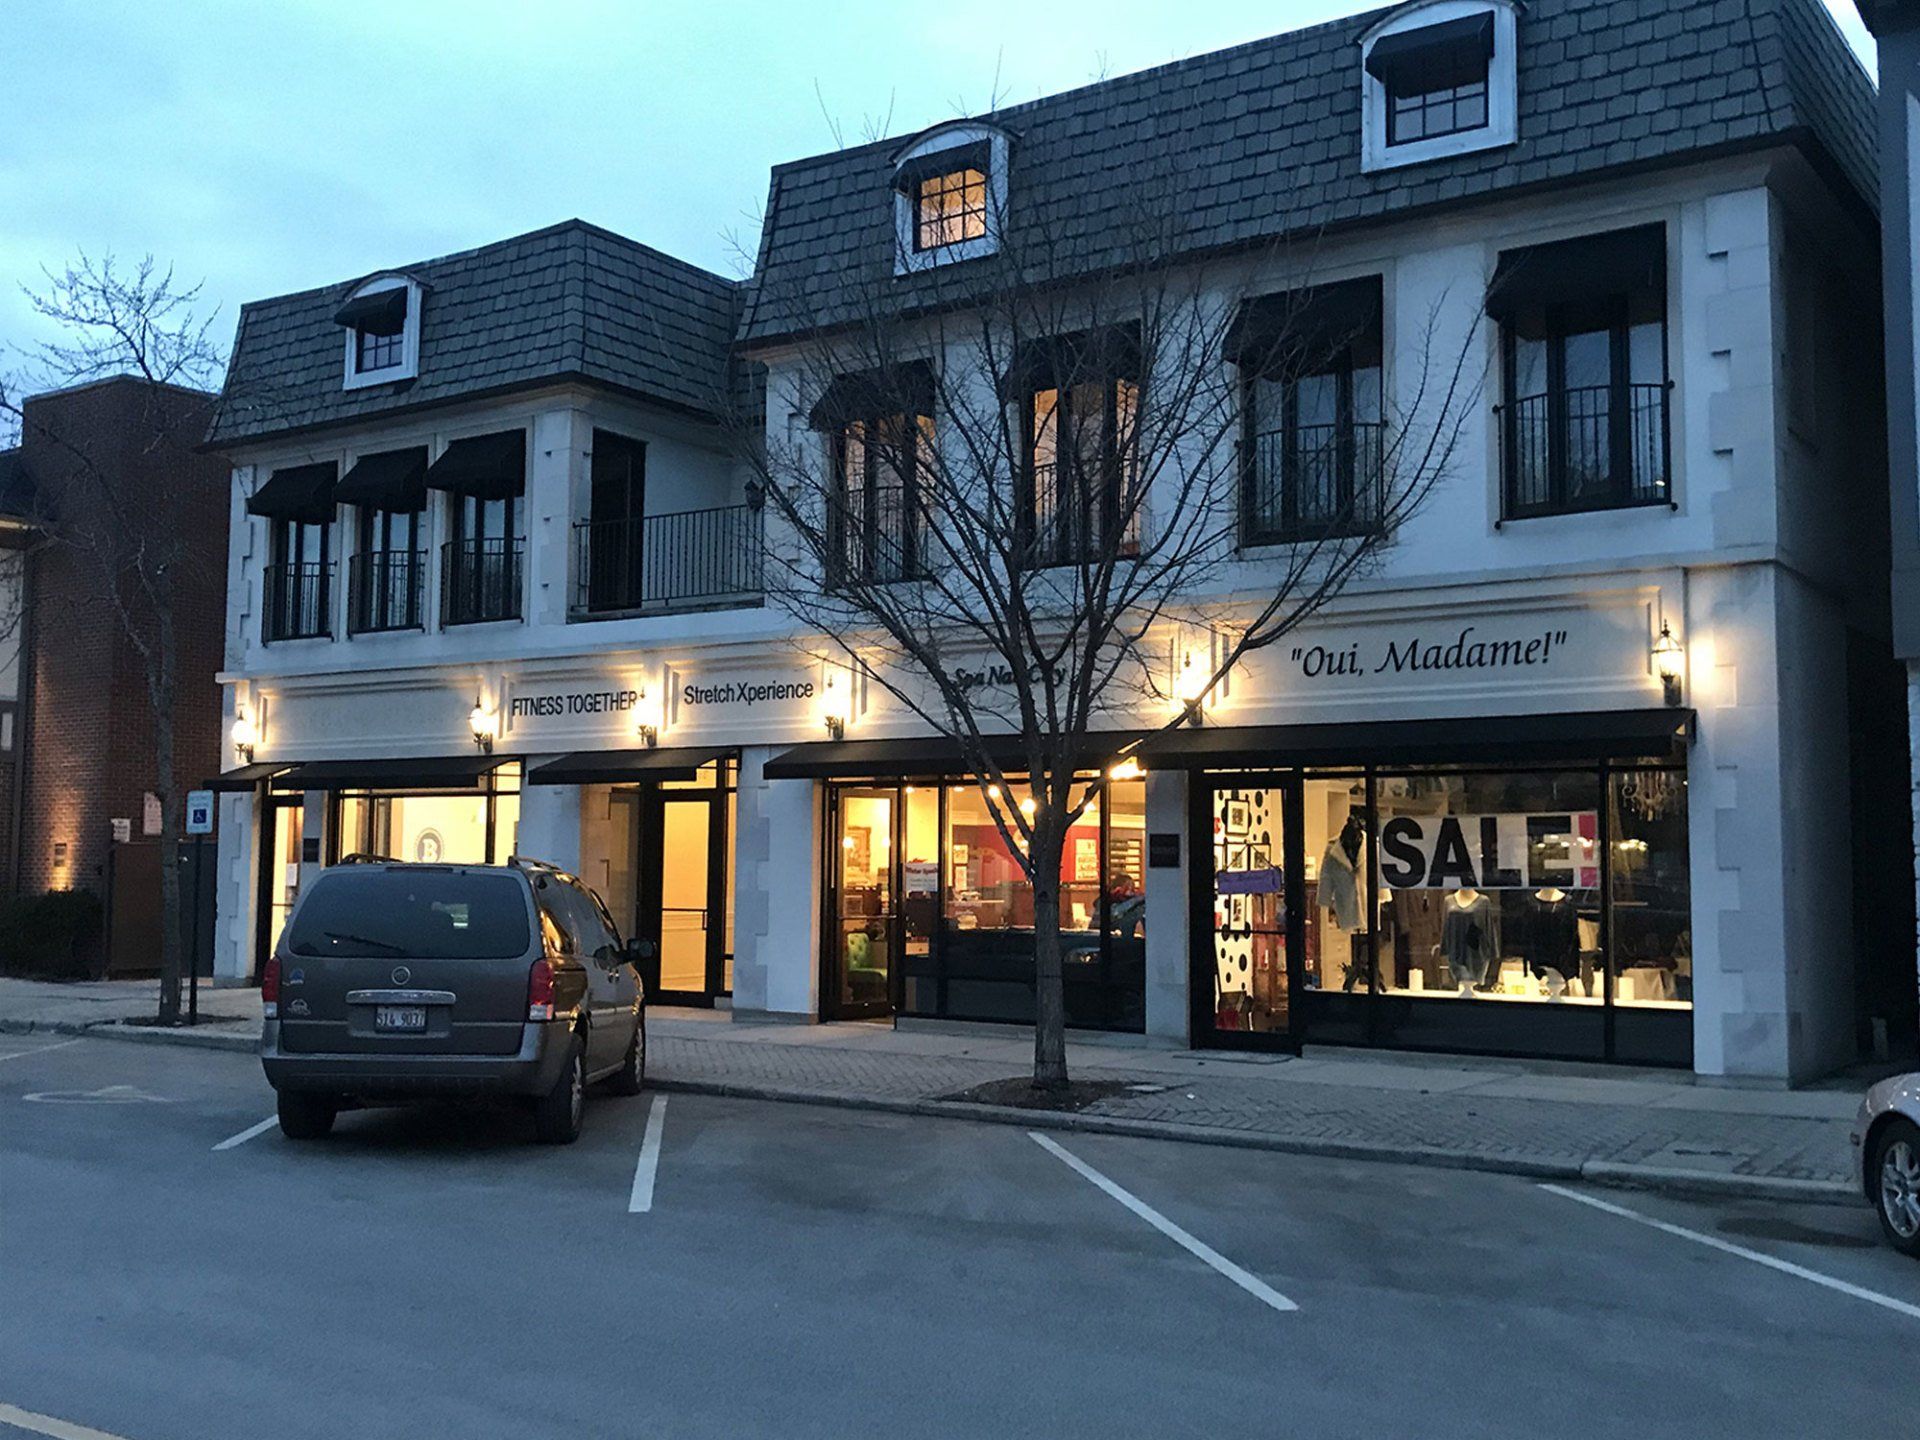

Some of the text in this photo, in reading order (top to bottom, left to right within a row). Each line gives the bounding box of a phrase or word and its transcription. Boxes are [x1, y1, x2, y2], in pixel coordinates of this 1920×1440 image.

[1290, 627, 1568, 677] "Oui, Madame!"
[511, 690, 638, 716] FITNESS TOGETHER
[1380, 814, 1598, 888] SALE!
